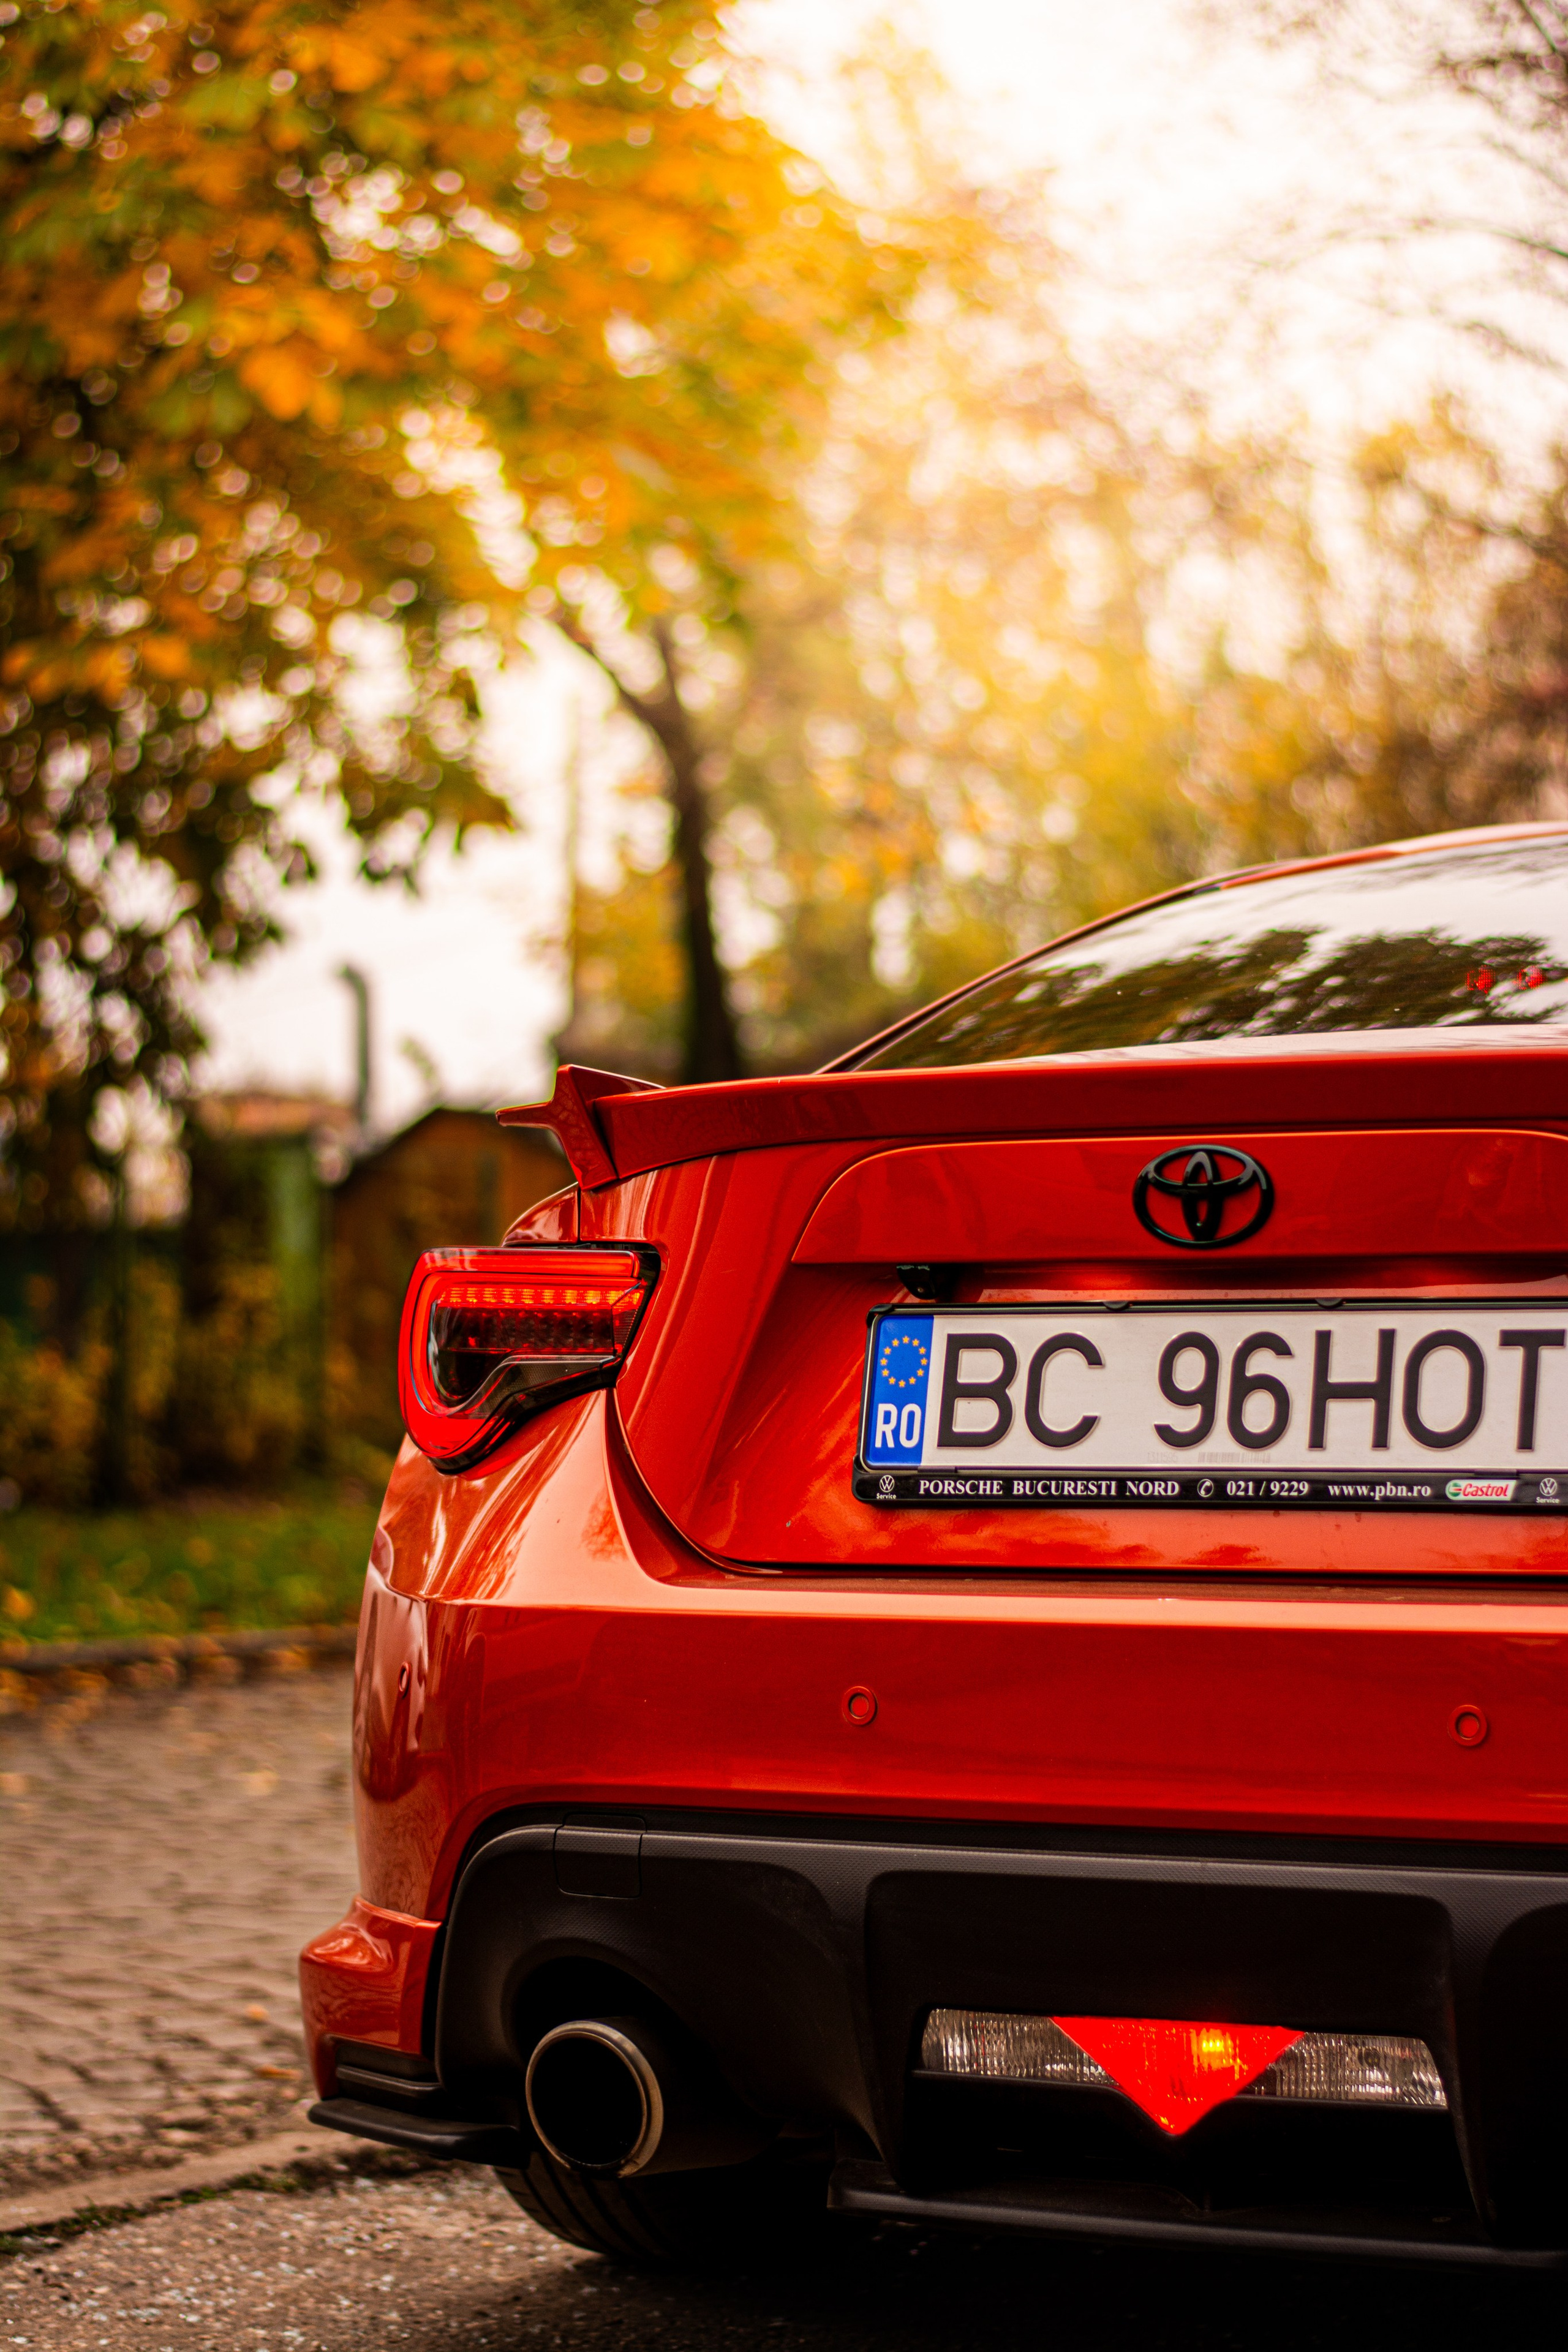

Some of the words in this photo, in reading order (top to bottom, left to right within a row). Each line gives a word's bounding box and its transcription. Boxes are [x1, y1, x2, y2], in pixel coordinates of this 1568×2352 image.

[937, 1333, 1104, 1448] BC
[875, 1403, 921, 1448] RO
[919, 1480, 1003, 1494] PORSCHE
[1012, 1480, 1117, 1495] BUCURESTI
[1126, 1481, 1179, 1496] NORD
[1227, 1480, 1254, 1496] 021
[1270, 1481, 1309, 1496] 9229
[1328, 1482, 1432, 1501] www.pbn.ro
[1462, 1483, 1509, 1497] Castrol
